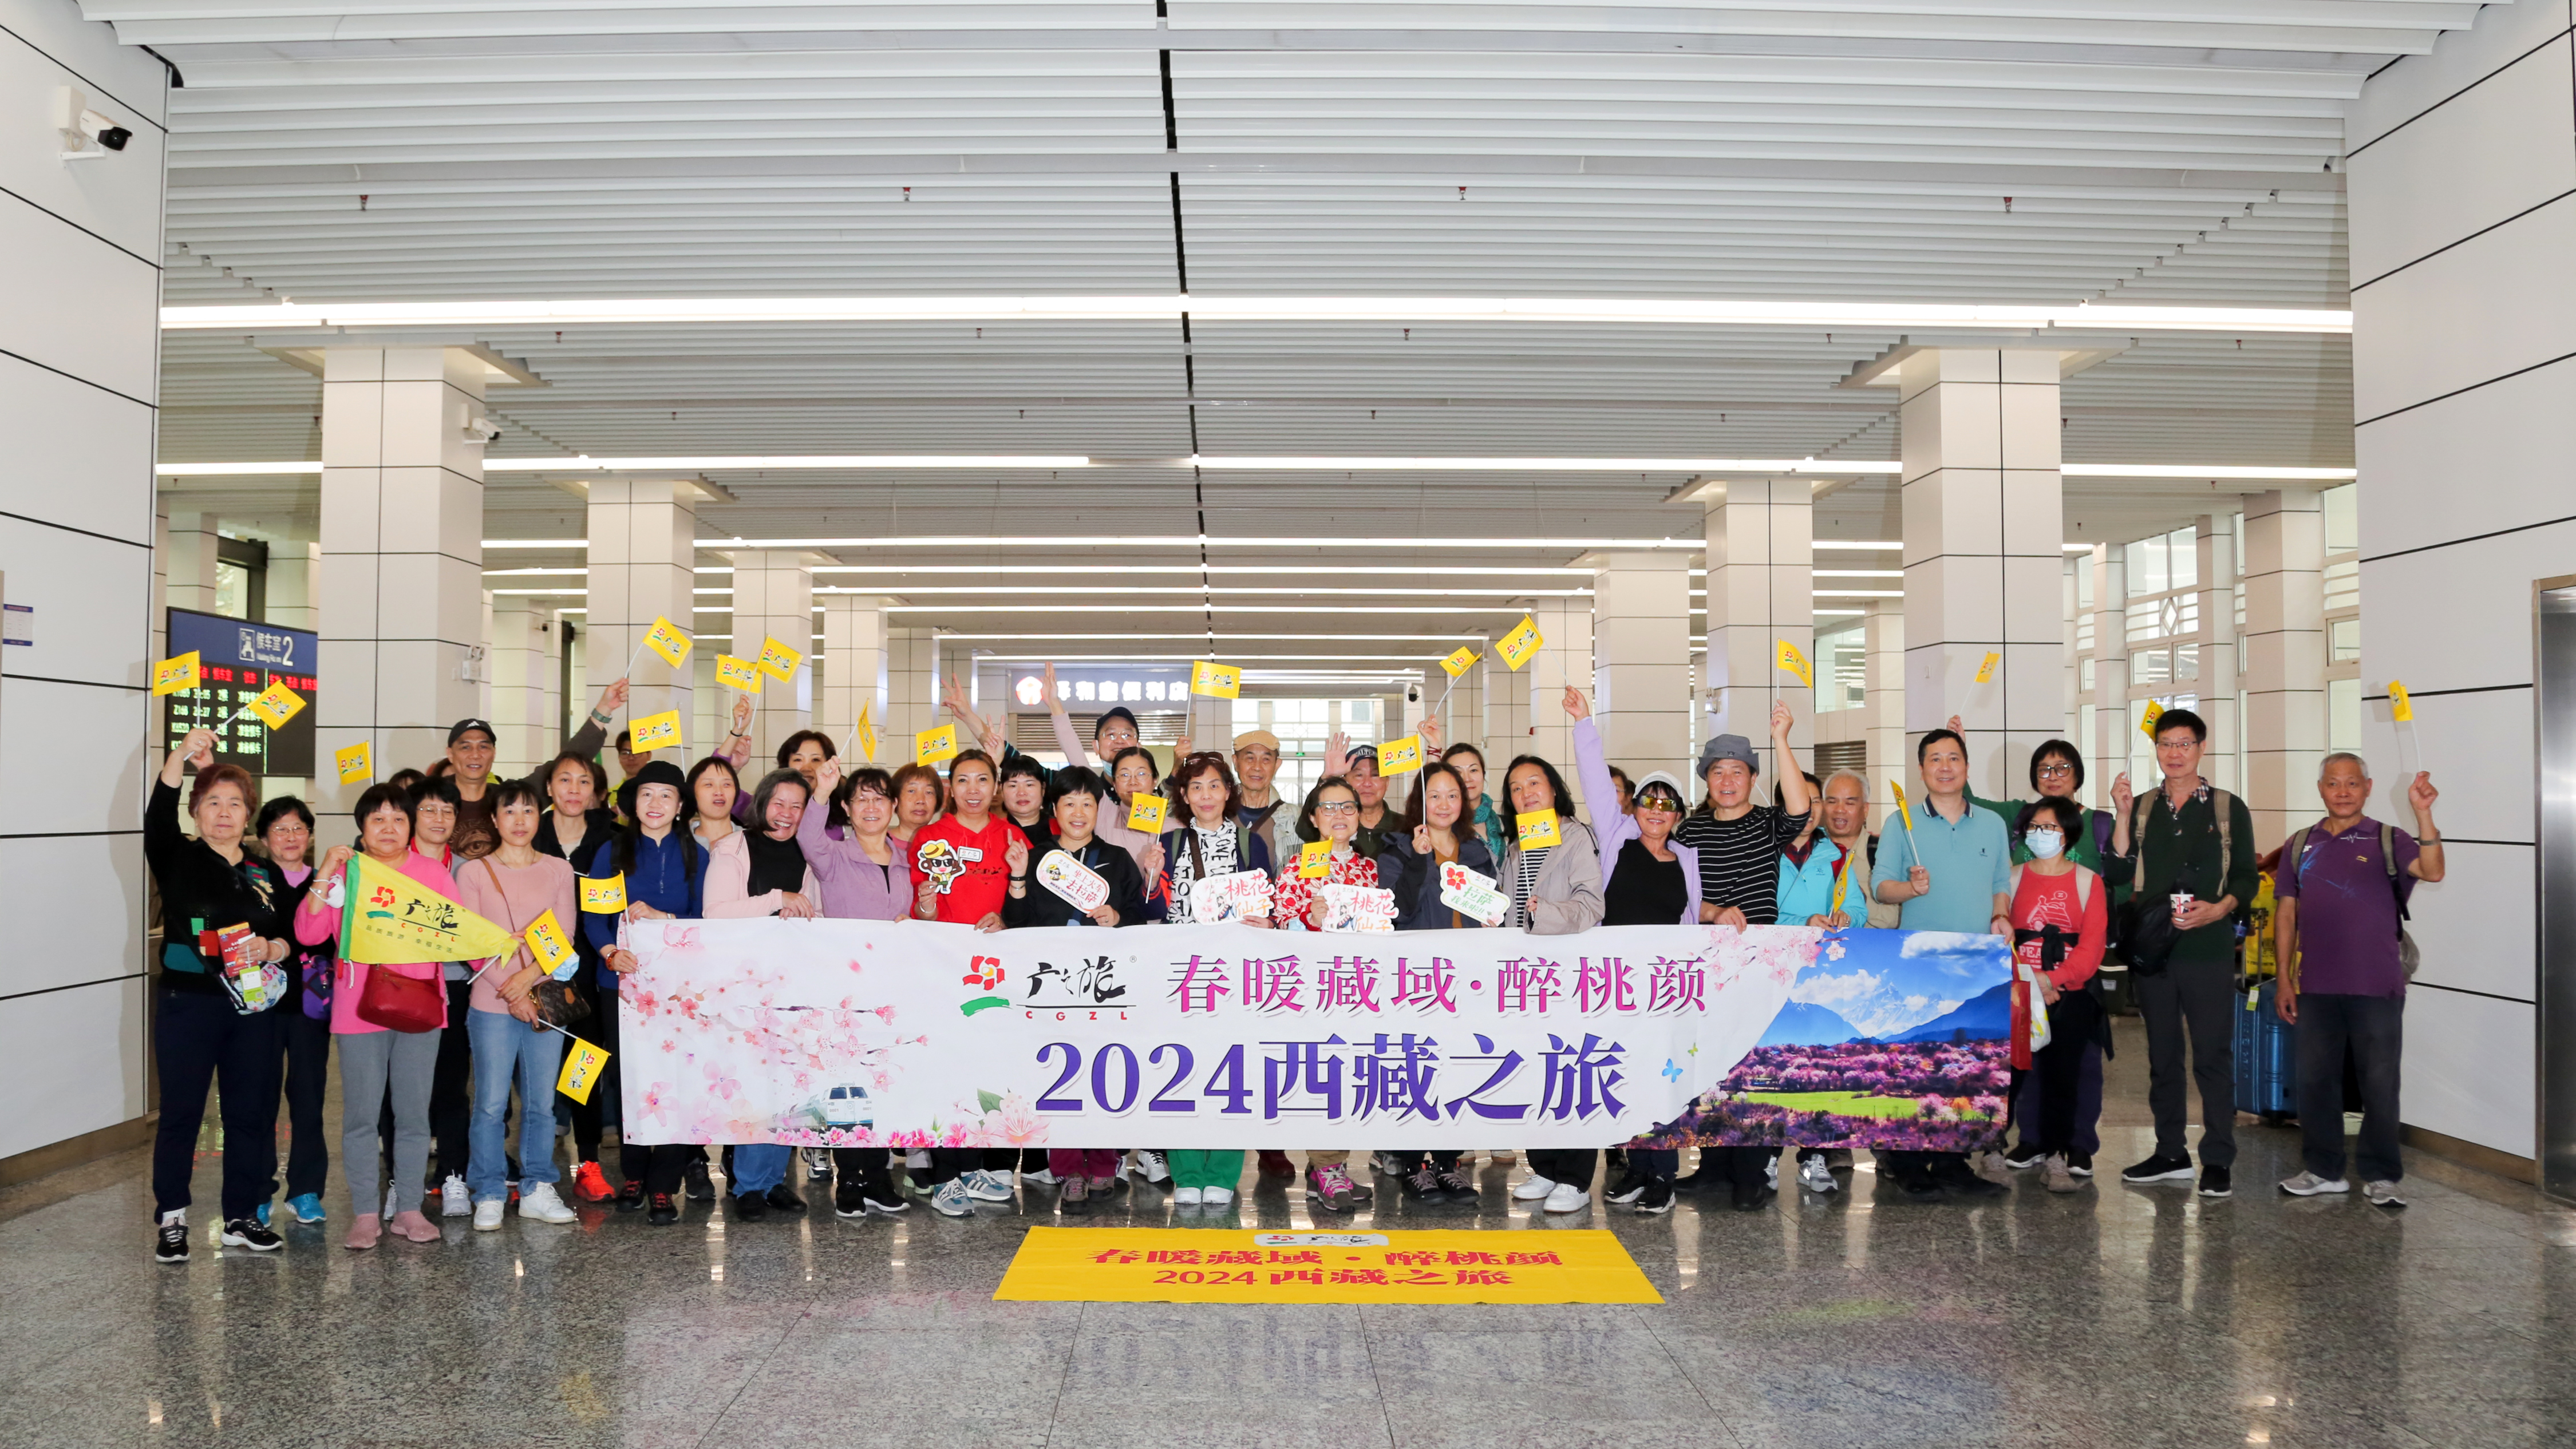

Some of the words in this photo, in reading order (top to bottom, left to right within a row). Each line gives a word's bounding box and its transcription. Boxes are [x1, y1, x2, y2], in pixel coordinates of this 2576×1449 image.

[256, 632, 282, 651] 候车室
[283, 636, 294, 667] 2
[1066, 880, 1099, 902] 去拉萨
[1073, 870, 1104, 893] 坐上火车
[1225, 871, 1271, 900] 桃花
[1236, 898, 1271, 917] 仙子
[1350, 890, 1397, 916] 桃花
[1463, 886, 1495, 905] 拉萨
[1356, 917, 1391, 932] 仙子
[366, 925, 404, 940] 品质旅游
[416, 939, 453, 953] 幸福生活
[1027, 956, 1127, 1003] 广之旅
[1167, 954, 1706, 1016] 春暖藏域·醉桃颜
[1036, 1032, 1626, 1122] 2024西藏之旅
[1153, 1268, 1515, 1286] 2024西藏之旅
